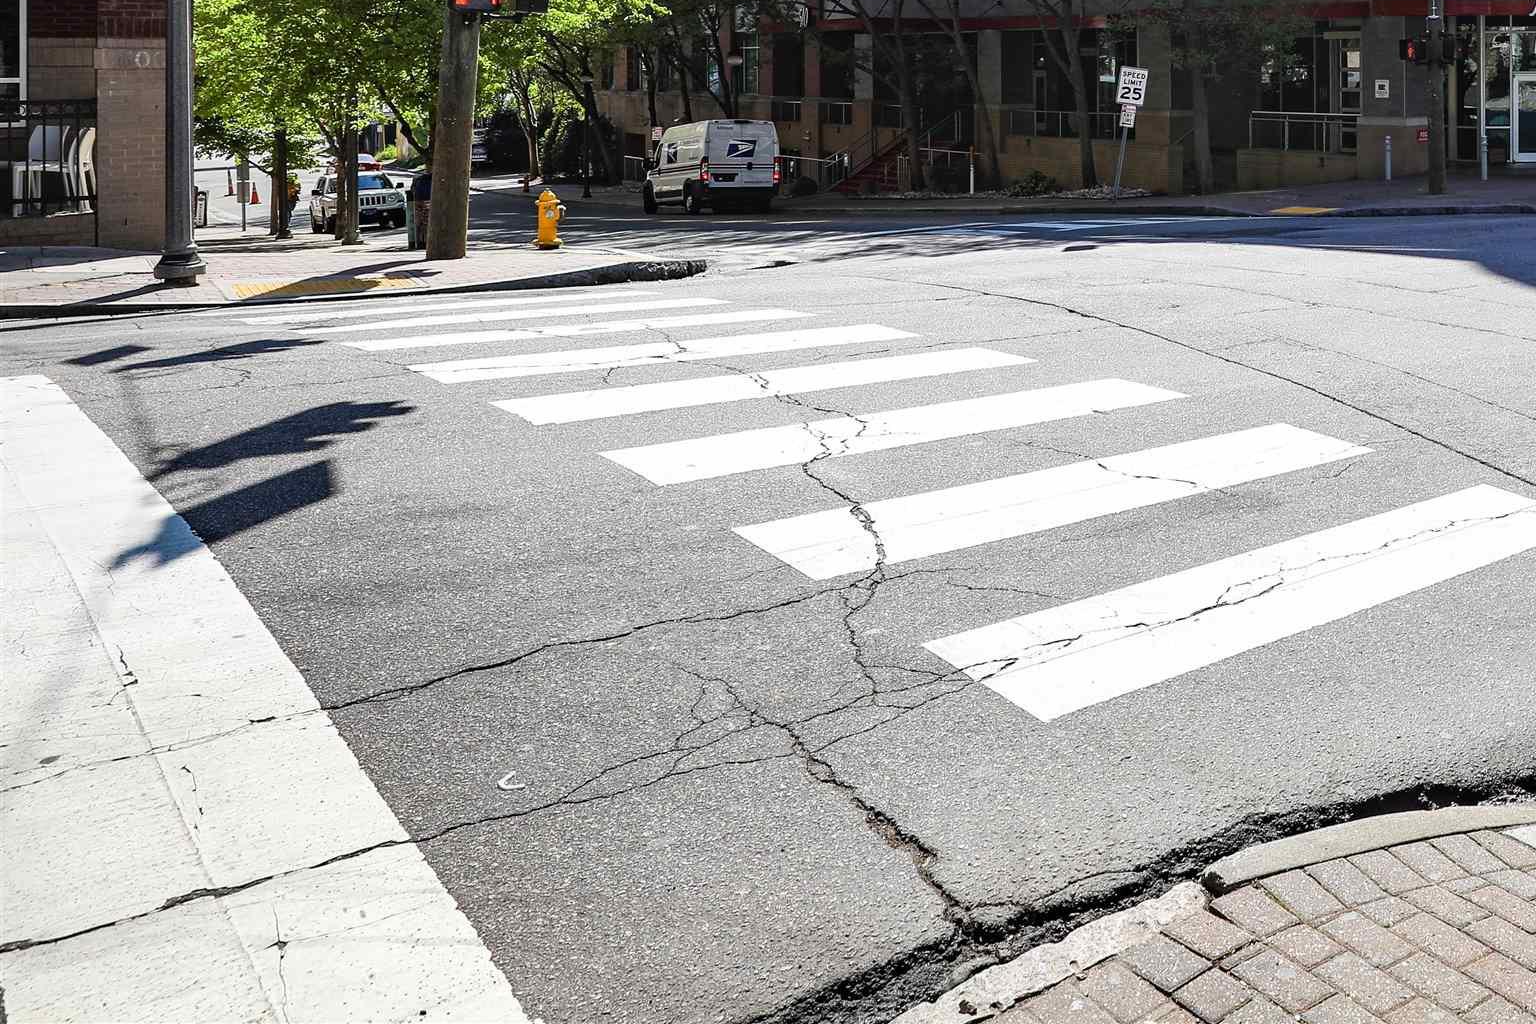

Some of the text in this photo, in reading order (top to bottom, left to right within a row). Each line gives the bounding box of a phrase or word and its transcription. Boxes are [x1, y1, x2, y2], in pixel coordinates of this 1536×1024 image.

[1122, 71, 1146, 80] SPEED
[1123, 78, 1142, 86] LIMIT
[1120, 86, 1142, 101] 25
